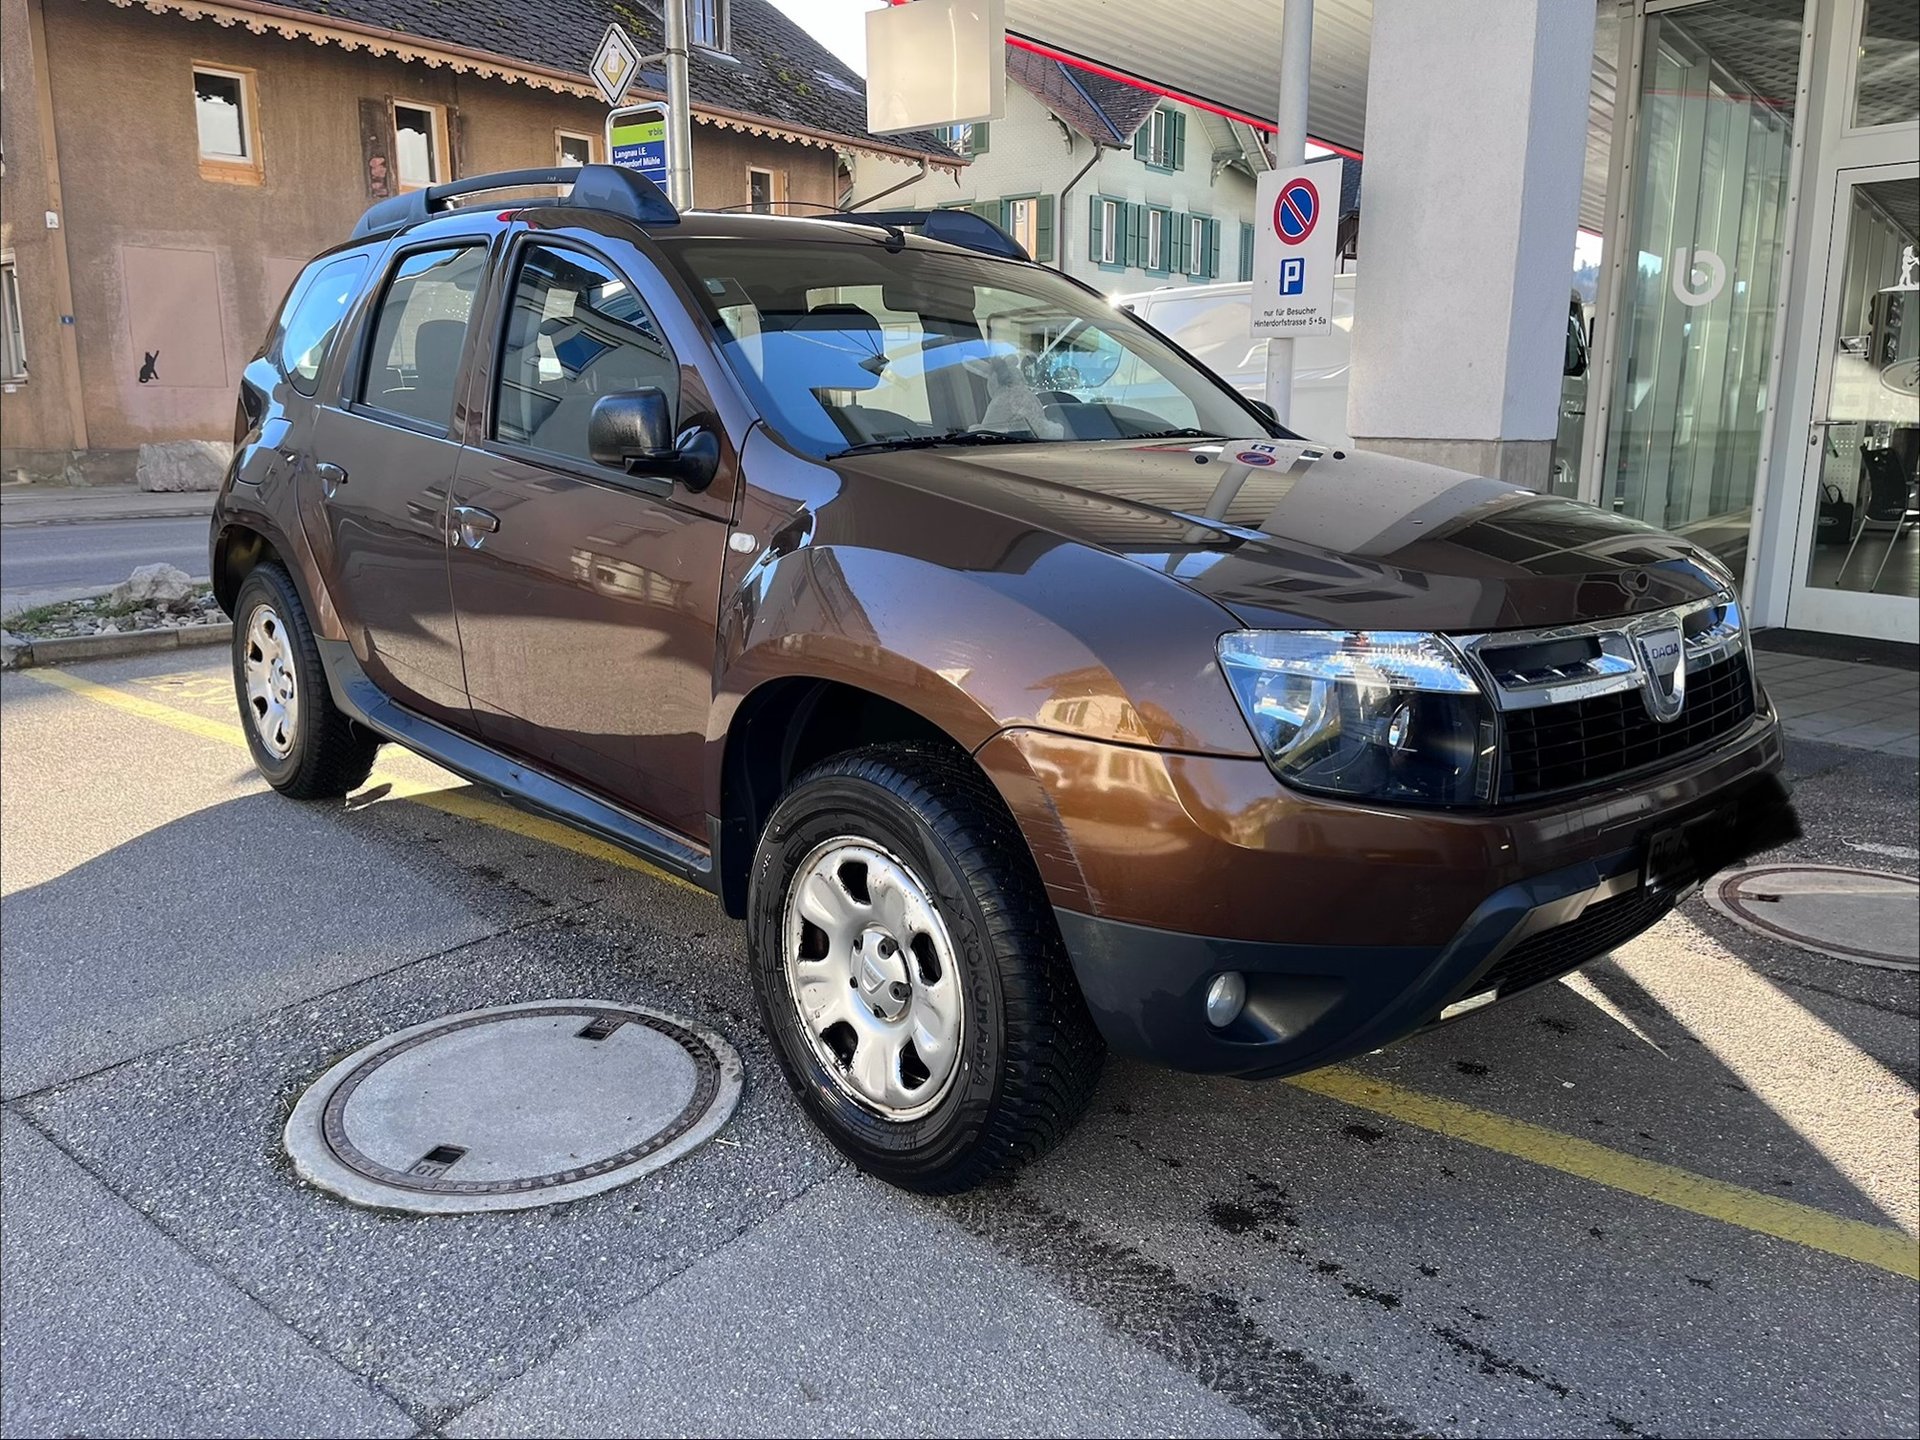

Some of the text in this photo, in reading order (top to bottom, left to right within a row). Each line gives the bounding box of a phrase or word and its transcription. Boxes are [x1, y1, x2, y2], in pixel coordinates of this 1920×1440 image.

[614, 150, 638, 159] Langnau
[643, 157, 660, 166] Mühle
[1283, 260, 1301, 293] P
[1275, 308, 1285, 316] für
[1287, 307, 1316, 315] Besucher
[1253, 319, 1306, 328] Hinterdorfstrasse
[1651, 643, 1680, 660] DACIA
[963, 926, 992, 1087] YOKOHAMA
